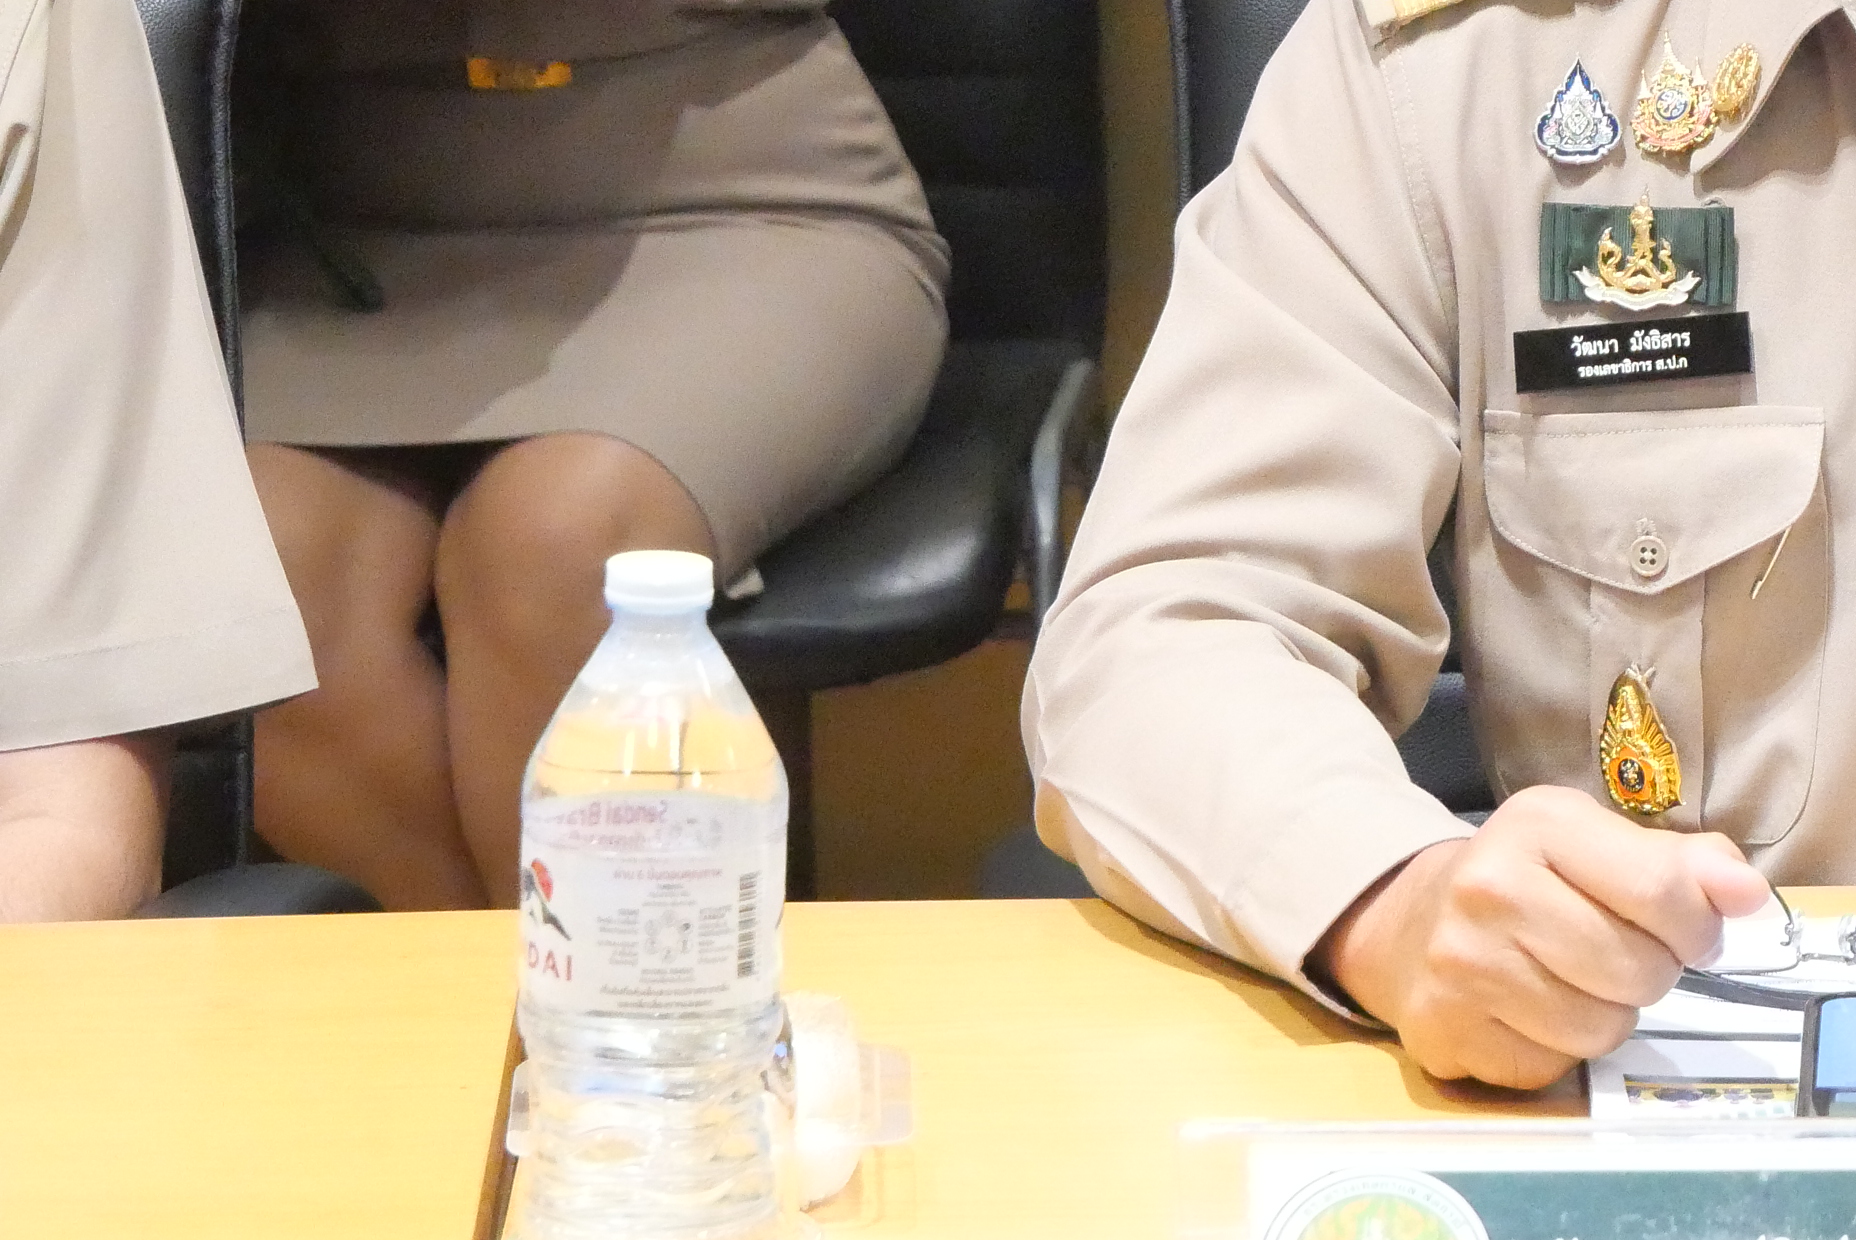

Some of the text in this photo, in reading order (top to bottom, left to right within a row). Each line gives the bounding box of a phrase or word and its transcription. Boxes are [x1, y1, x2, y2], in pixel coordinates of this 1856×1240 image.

[1570, 329, 1691, 356] วัฒนา มังธิสาร
[1577, 359, 1653, 378] รองเลขาธิการ
